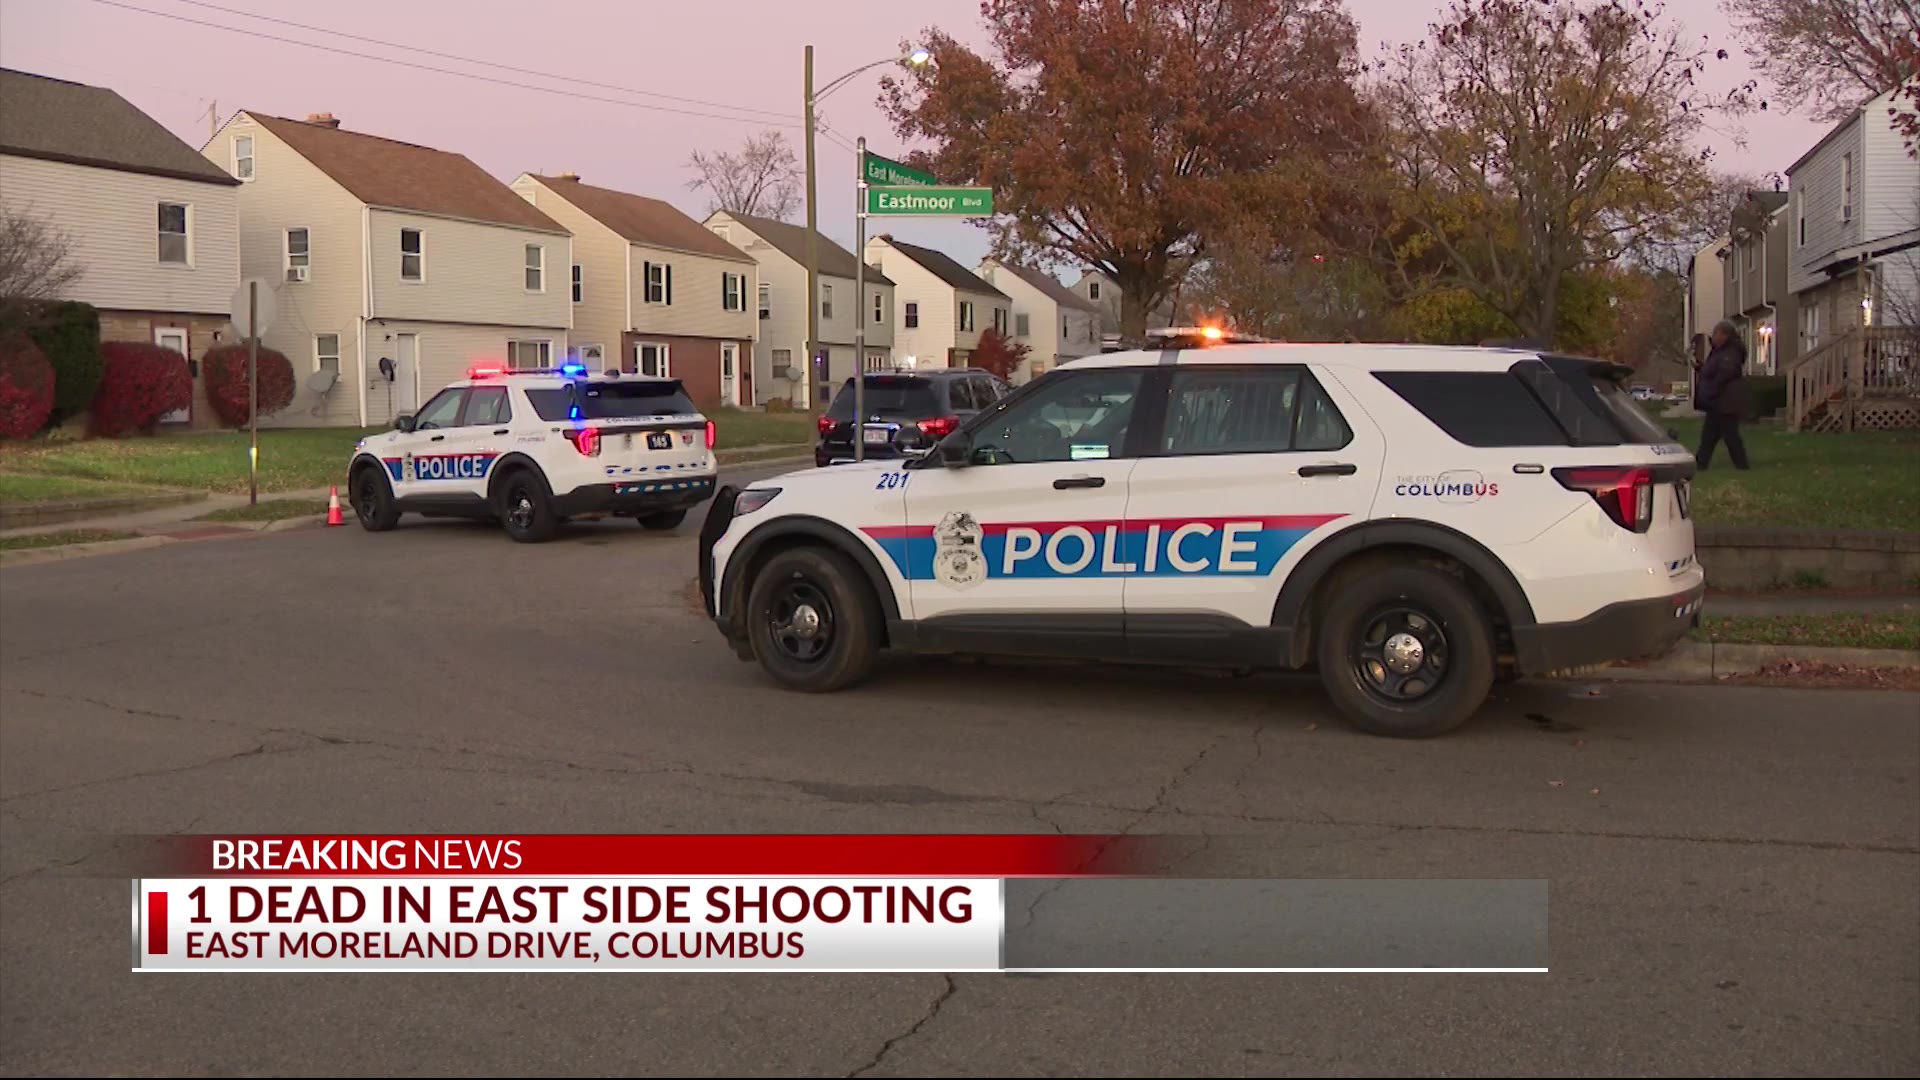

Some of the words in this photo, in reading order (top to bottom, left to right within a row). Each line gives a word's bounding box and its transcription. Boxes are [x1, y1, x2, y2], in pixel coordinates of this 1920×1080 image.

[868, 161, 887, 182] East
[878, 193, 955, 209] Eastmoor
[962, 198, 982, 206] Blvd
[418, 455, 484, 478] POLICE
[876, 472, 909, 490] 201
[1395, 483, 1499, 496] COLUMBUS
[1003, 522, 1263, 574] POLICE
